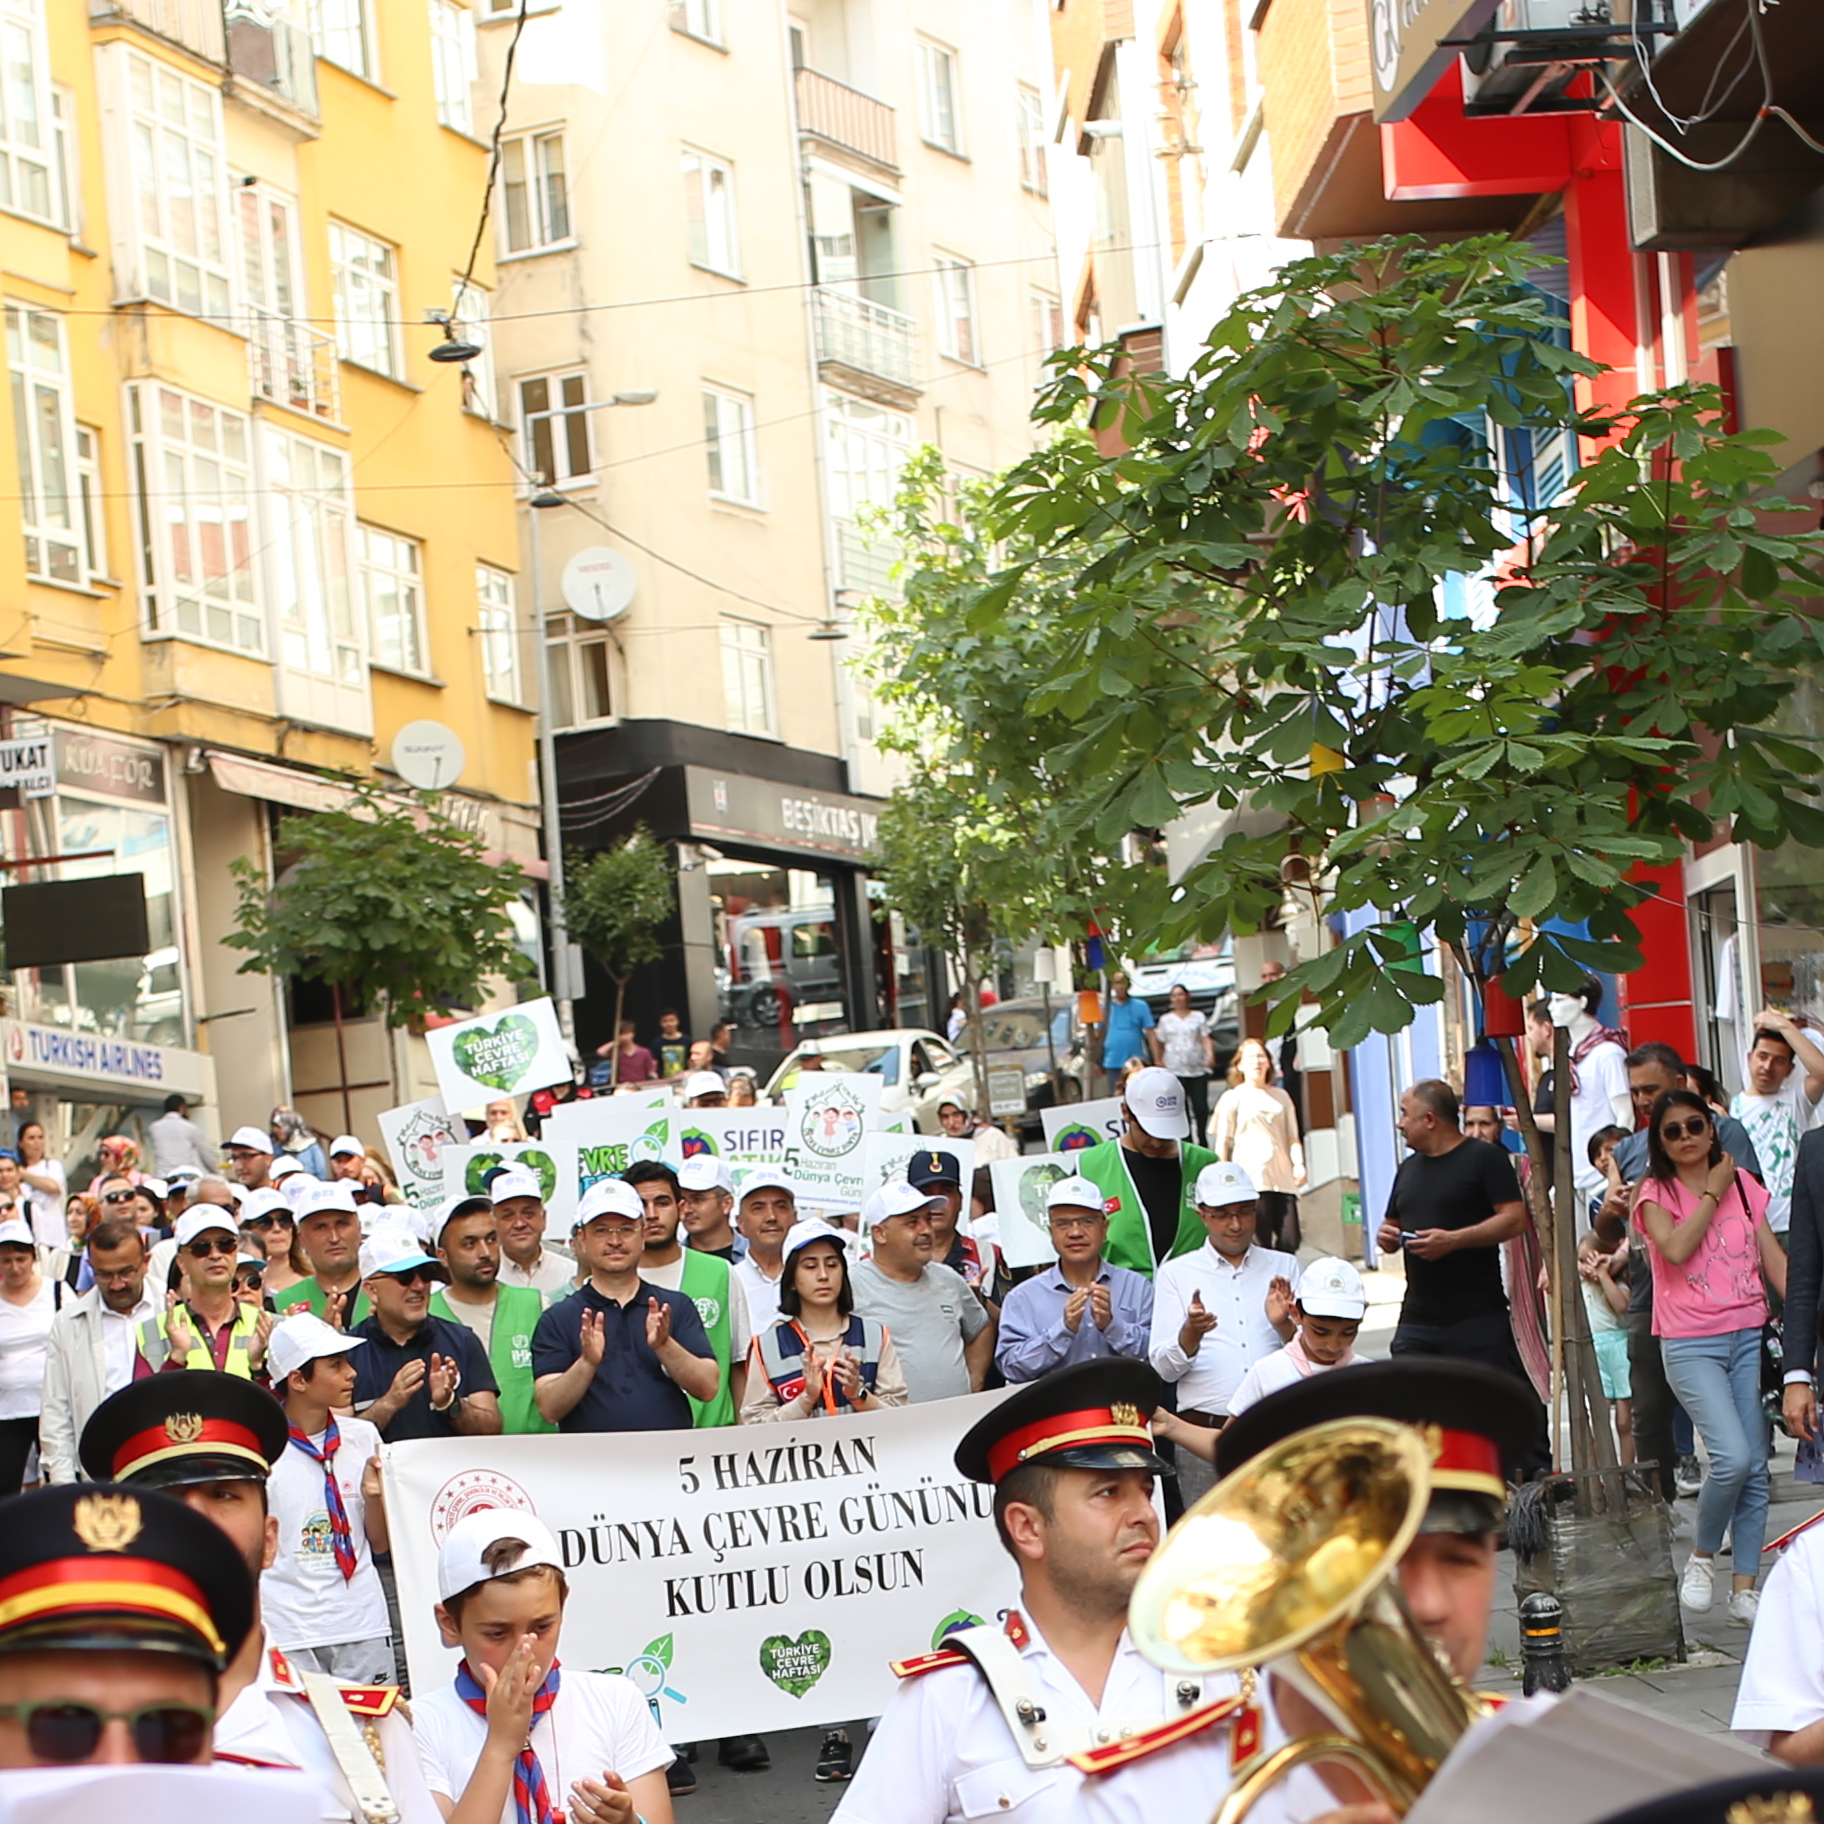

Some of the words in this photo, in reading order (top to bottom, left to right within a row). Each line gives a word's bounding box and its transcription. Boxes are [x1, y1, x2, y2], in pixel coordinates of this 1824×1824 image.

[781, 796, 860, 846] BEŞİKTAŞ
[463, 1028, 525, 1055] TÜRKİYE
[474, 1042, 522, 1065] ÇEVRE
[28, 1030, 98, 1071] TURKISH
[99, 1043, 163, 1081] AIRLINES
[471, 1053, 530, 1077] HAFTASI
[723, 1129, 785, 1151] SIFIR
[782, 1148, 801, 1177] 5
[800, 1156, 837, 1171] Haziran
[793, 1168, 831, 1184] Dünya
[834, 1173, 864, 1187] Çevr
[678, 1456, 701, 1495] 5
[711, 1436, 881, 1492] HAZİRAN
[557, 1513, 693, 1570] DÜNYA
[703, 1501, 830, 1564] ÇEVRE
[664, 1562, 792, 1620] KUTLU
[803, 1547, 926, 1598] OLSUN
[769, 1642, 821, 1660] TÜRKİYE
[776, 1655, 816, 1670] ÇEVRE
[772, 1664, 822, 1680] HAFTASI
